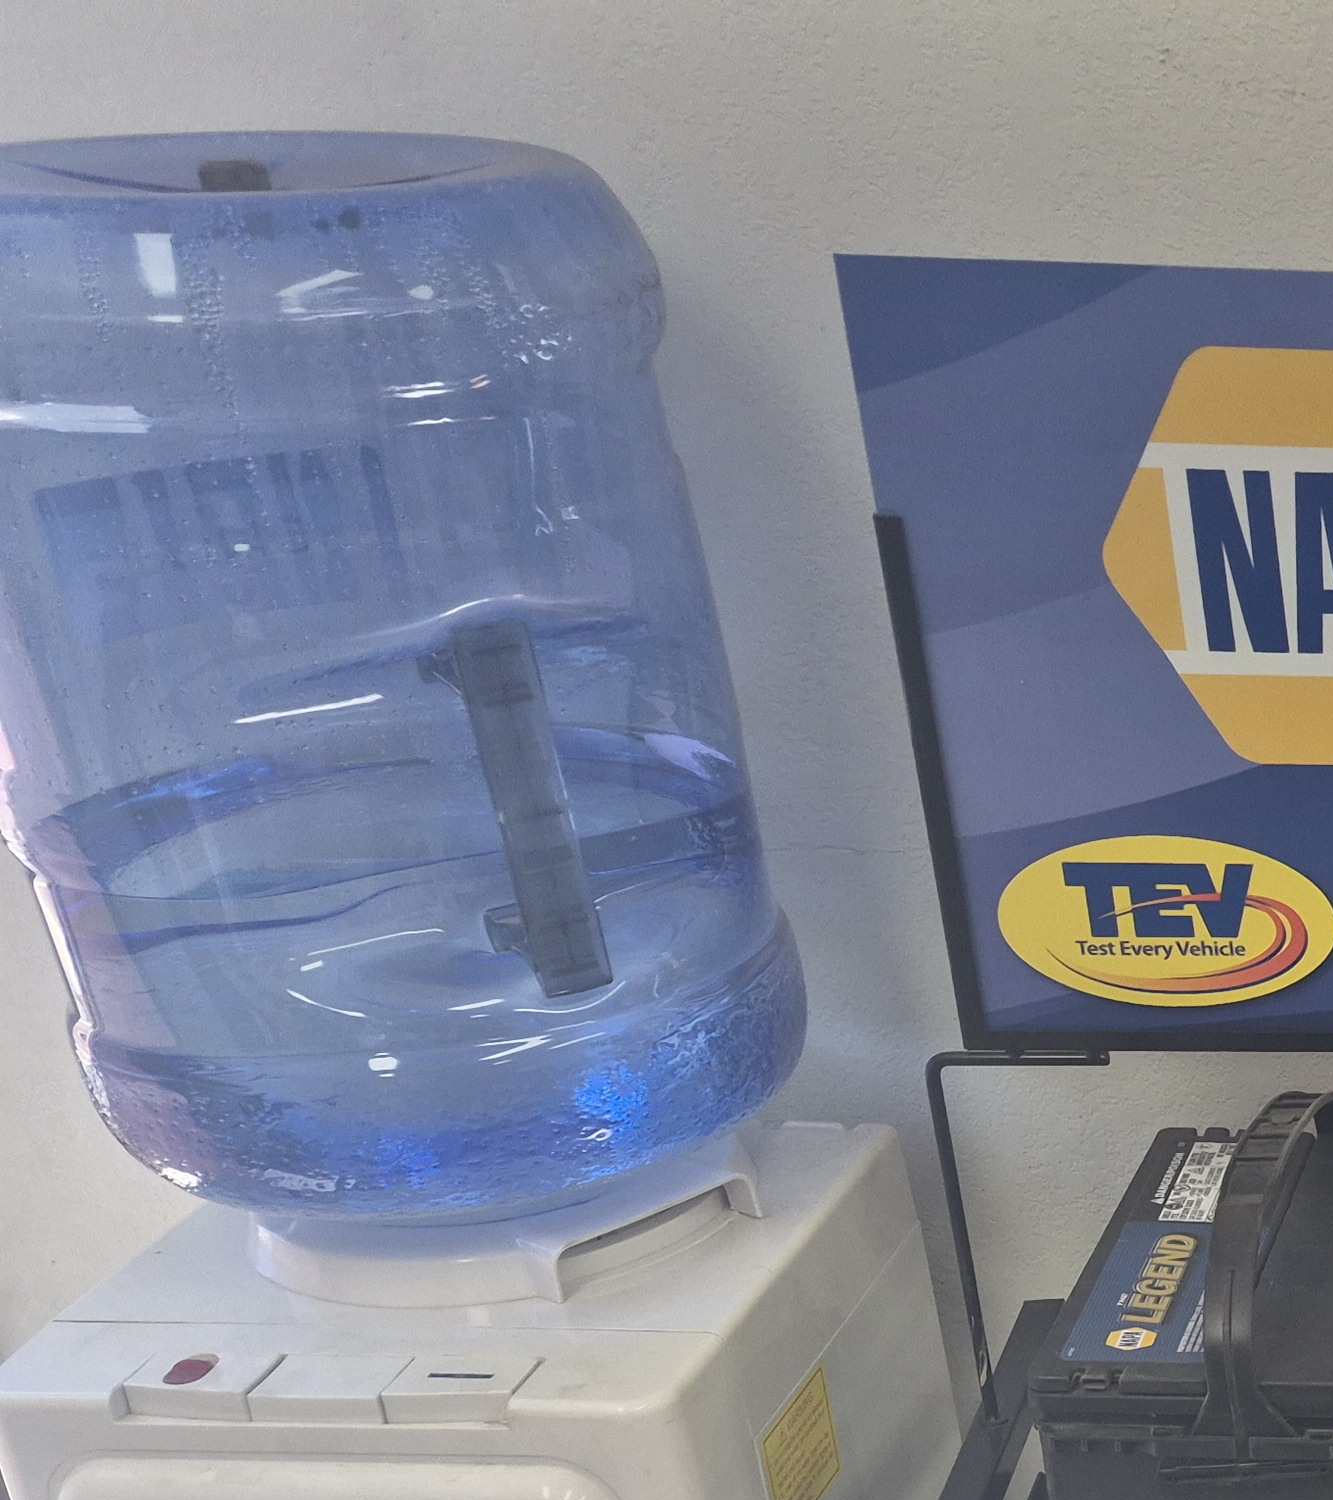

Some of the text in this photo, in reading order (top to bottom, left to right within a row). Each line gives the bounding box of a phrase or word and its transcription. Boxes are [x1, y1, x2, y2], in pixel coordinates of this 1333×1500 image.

[1061, 862, 1254, 938] TEV
[1075, 940, 1246, 961] Test Every Vehicle
[1119, 1233, 1198, 1324] LEGEND
[1119, 1331, 1143, 1347] NAPA
